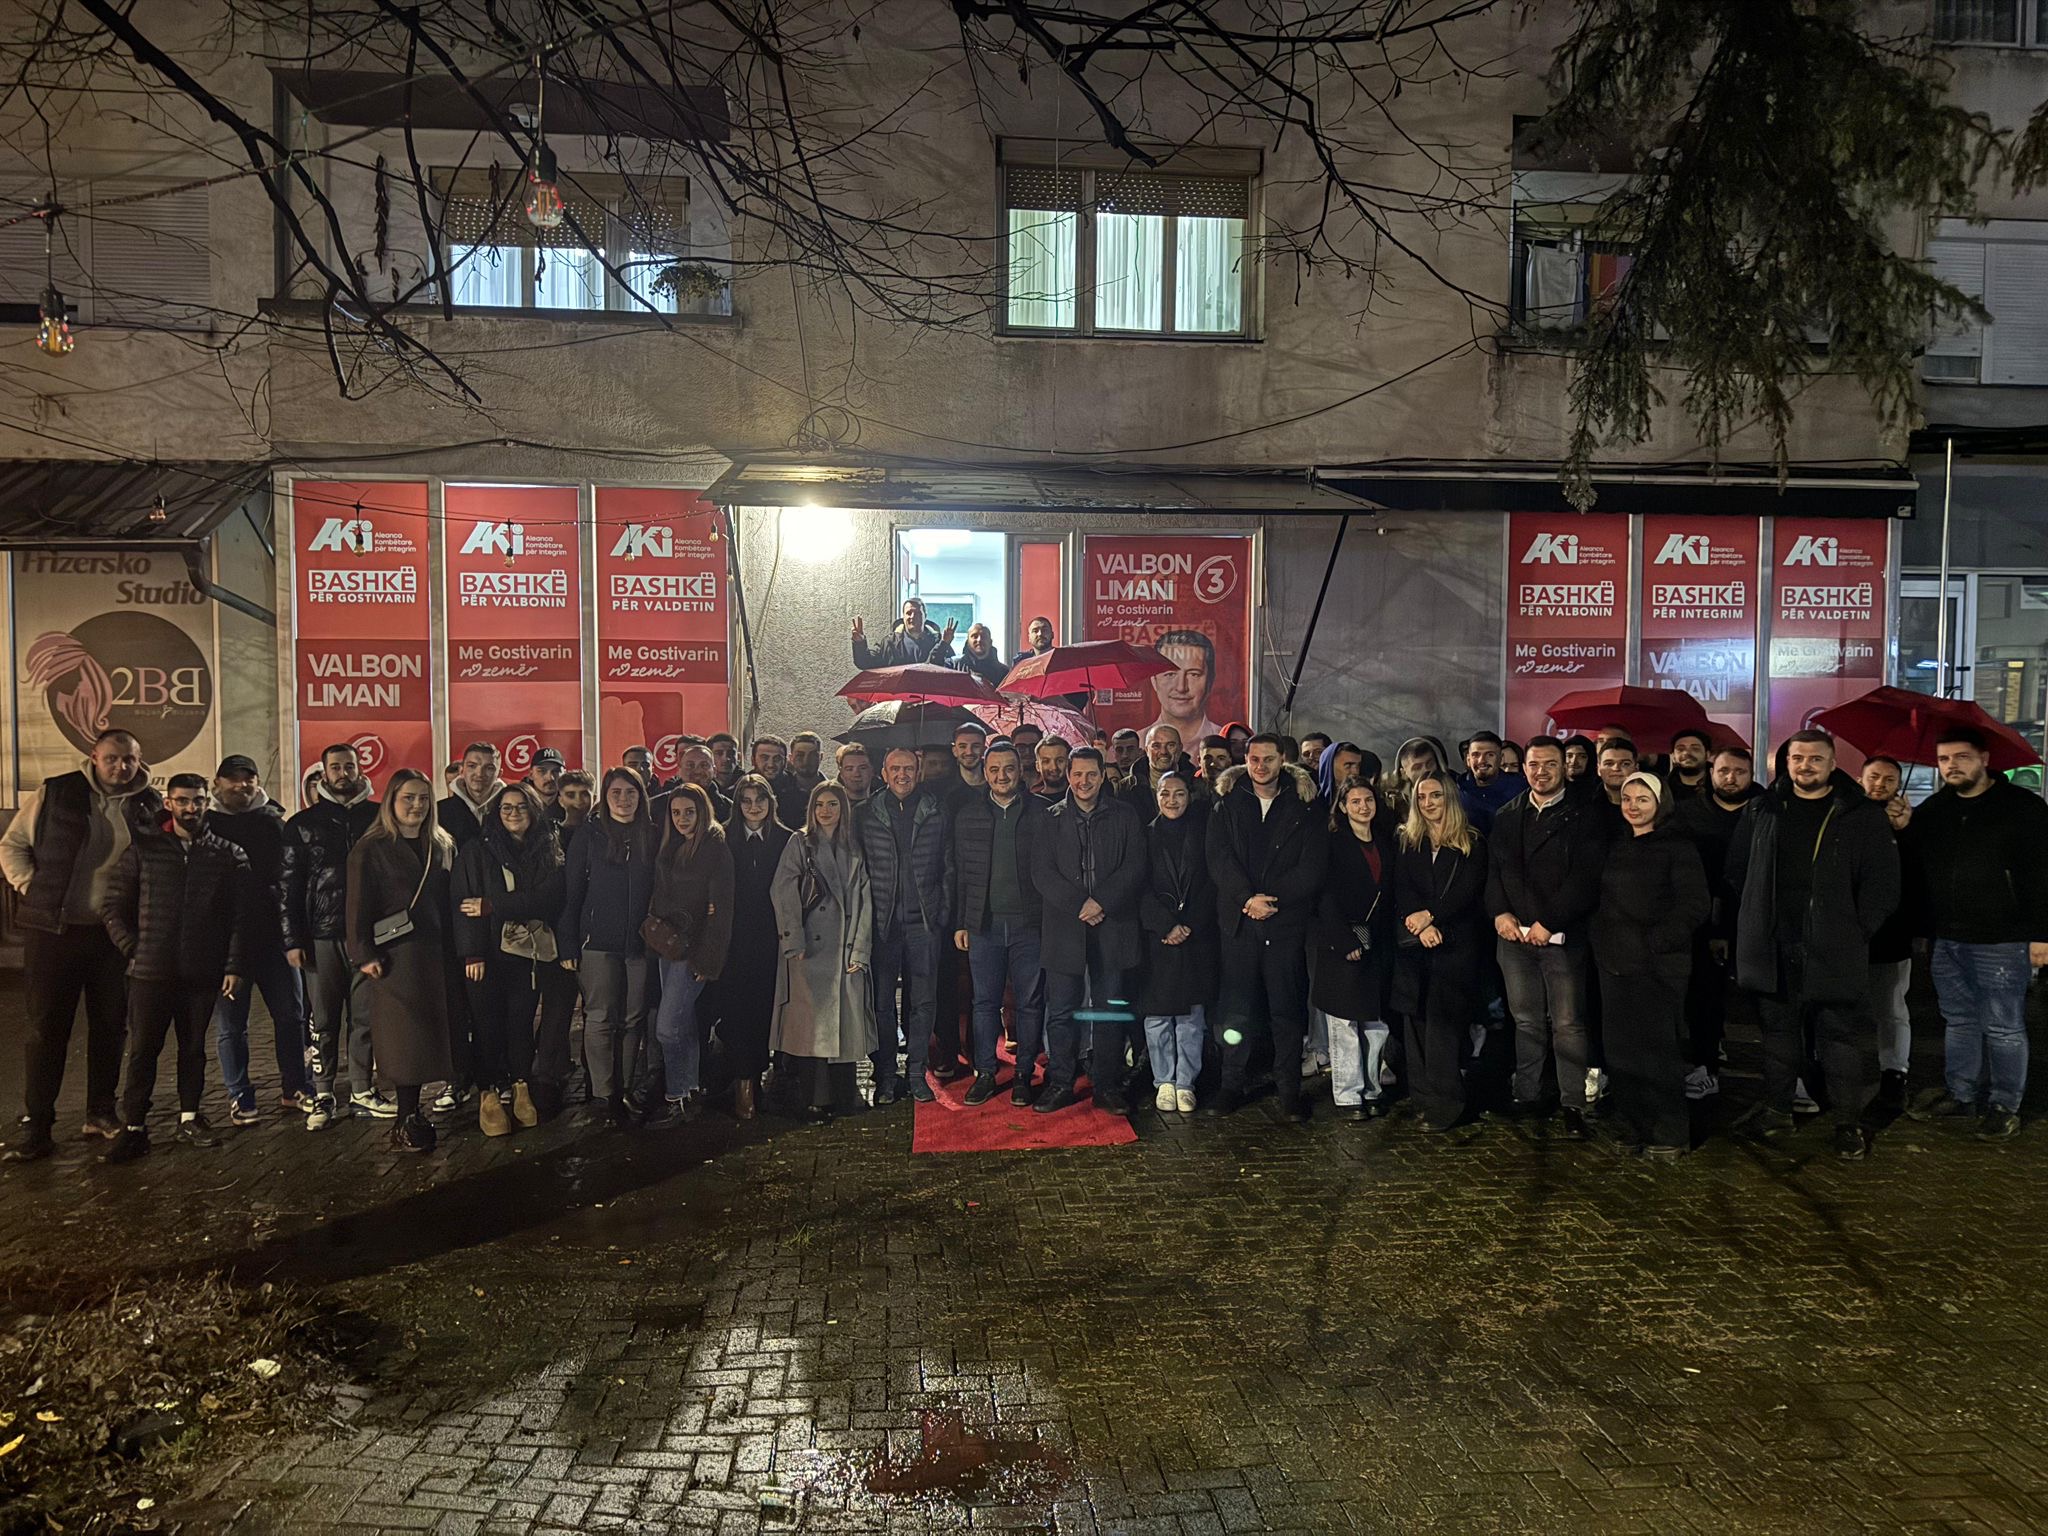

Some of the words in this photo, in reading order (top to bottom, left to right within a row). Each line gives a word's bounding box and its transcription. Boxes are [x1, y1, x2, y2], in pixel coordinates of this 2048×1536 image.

[21, 551, 152, 575] Frizersko
[1096, 553, 1192, 575] VALBON
[311, 567, 415, 591] BASHKË
[463, 570, 566, 594] BASHKË
[613, 573, 714, 596] BASHKË
[1207, 568, 1225, 594] 3
[116, 580, 207, 605] Studio
[309, 592, 334, 603] PËR
[338, 593, 416, 604] GOSTIVARIN
[461, 594, 487, 607] PËR
[492, 596, 566, 607] VALBONIN
[1095, 580, 1174, 601] LIMANI
[1522, 582, 1613, 604] BASHKË
[1654, 582, 1743, 604] BASHKË
[1784, 583, 1871, 605] BASHKË
[612, 598, 639, 611] PËR
[644, 601, 714, 612] VALDETIN
[1097, 605, 1114, 615] Me
[1116, 604, 1173, 615] Gostivarin
[1520, 605, 1543, 616] PËR
[1548, 607, 1612, 616] VALBONIN
[1653, 606, 1676, 619] PËR
[1681, 608, 1743, 619] INTEGRIM
[1781, 607, 1804, 620] PËR
[1809, 610, 1870, 620] VALDETIN
[459, 646, 484, 660] Me
[488, 644, 572, 660] Gostivarin
[608, 645, 633, 660] Me
[637, 646, 719, 661] Gostivarin
[1515, 644, 1537, 657] Me
[1542, 644, 1616, 658] Gostivarin
[307, 653, 422, 678] VALBON
[482, 663, 539, 678] zemër
[630, 664, 686, 678] zemër
[1649, 651, 1746, 674] VABON
[307, 683, 400, 707] LIMANI
[359, 746, 373, 765] 3
[515, 744, 530, 764] 3
[663, 744, 677, 763] 3
